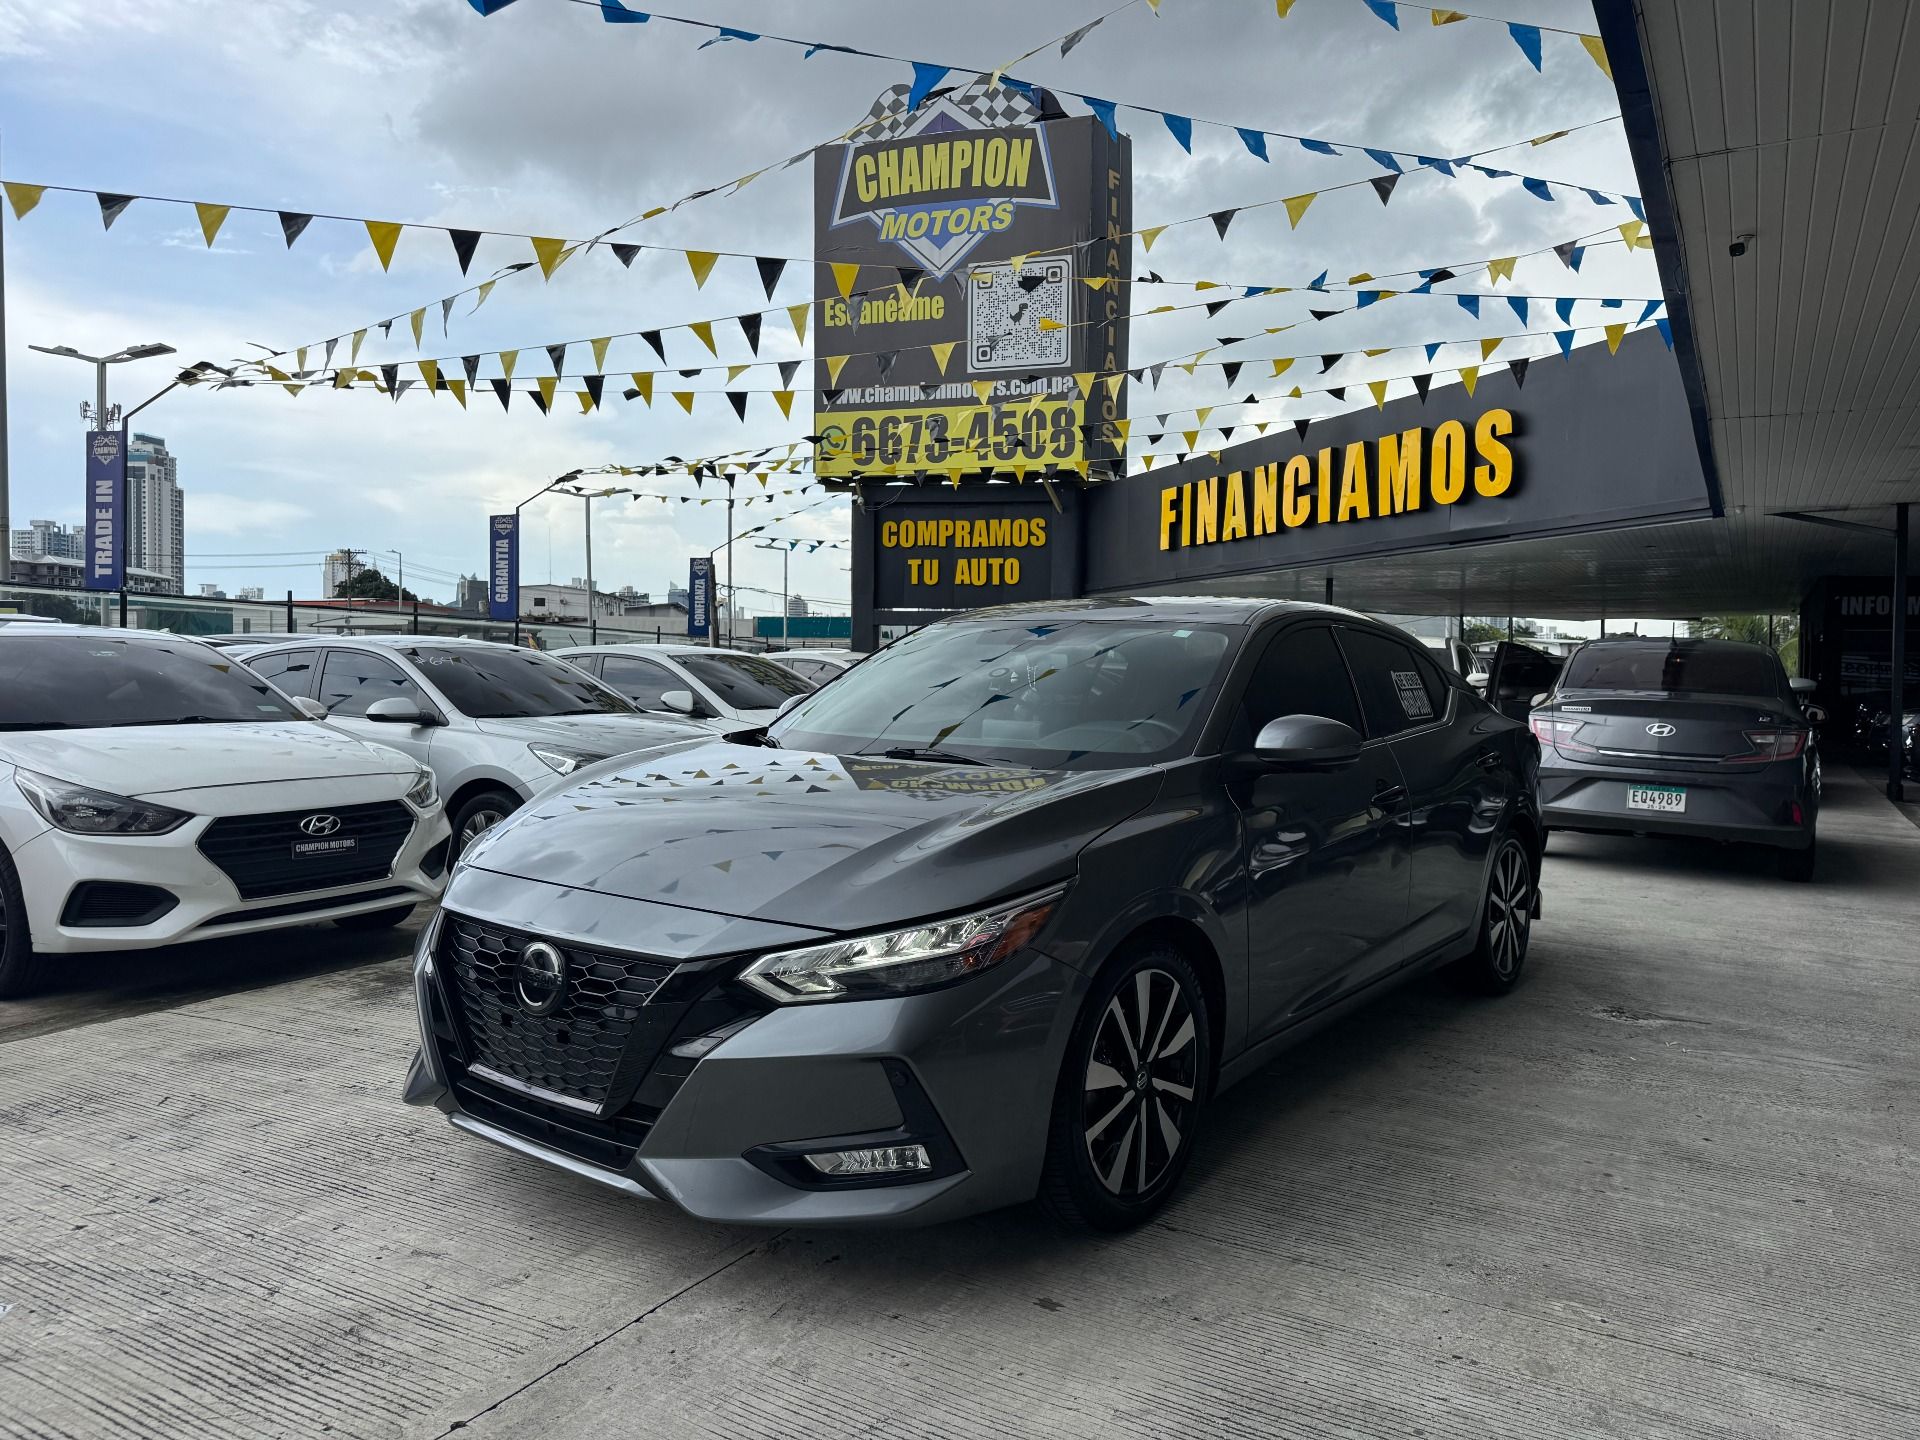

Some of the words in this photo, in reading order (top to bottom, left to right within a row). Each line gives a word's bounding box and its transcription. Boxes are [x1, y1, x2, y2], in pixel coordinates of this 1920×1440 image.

[855, 138, 1033, 203] CHAMPION
[880, 203, 1015, 241] MOTORS
[824, 294, 945, 327] Esanéame
[852, 407, 1076, 466] 6673-4508
[96, 480, 113, 503] IN
[1160, 408, 1514, 551] FINANCIAMOS
[94, 507, 113, 578] TRADE
[882, 518, 1047, 548] COMPRAMOS
[495, 539, 509, 603] GARANTIA
[908, 559, 939, 586] TU
[955, 558, 1020, 586] AUTO
[694, 578, 706, 627] CONFIANZA
[1840, 594, 1920, 616] INFOM
[1632, 790, 1682, 806] EQ4989
[295, 841, 329, 853] CHAMPION
[330, 838, 356, 849] MOTORS
